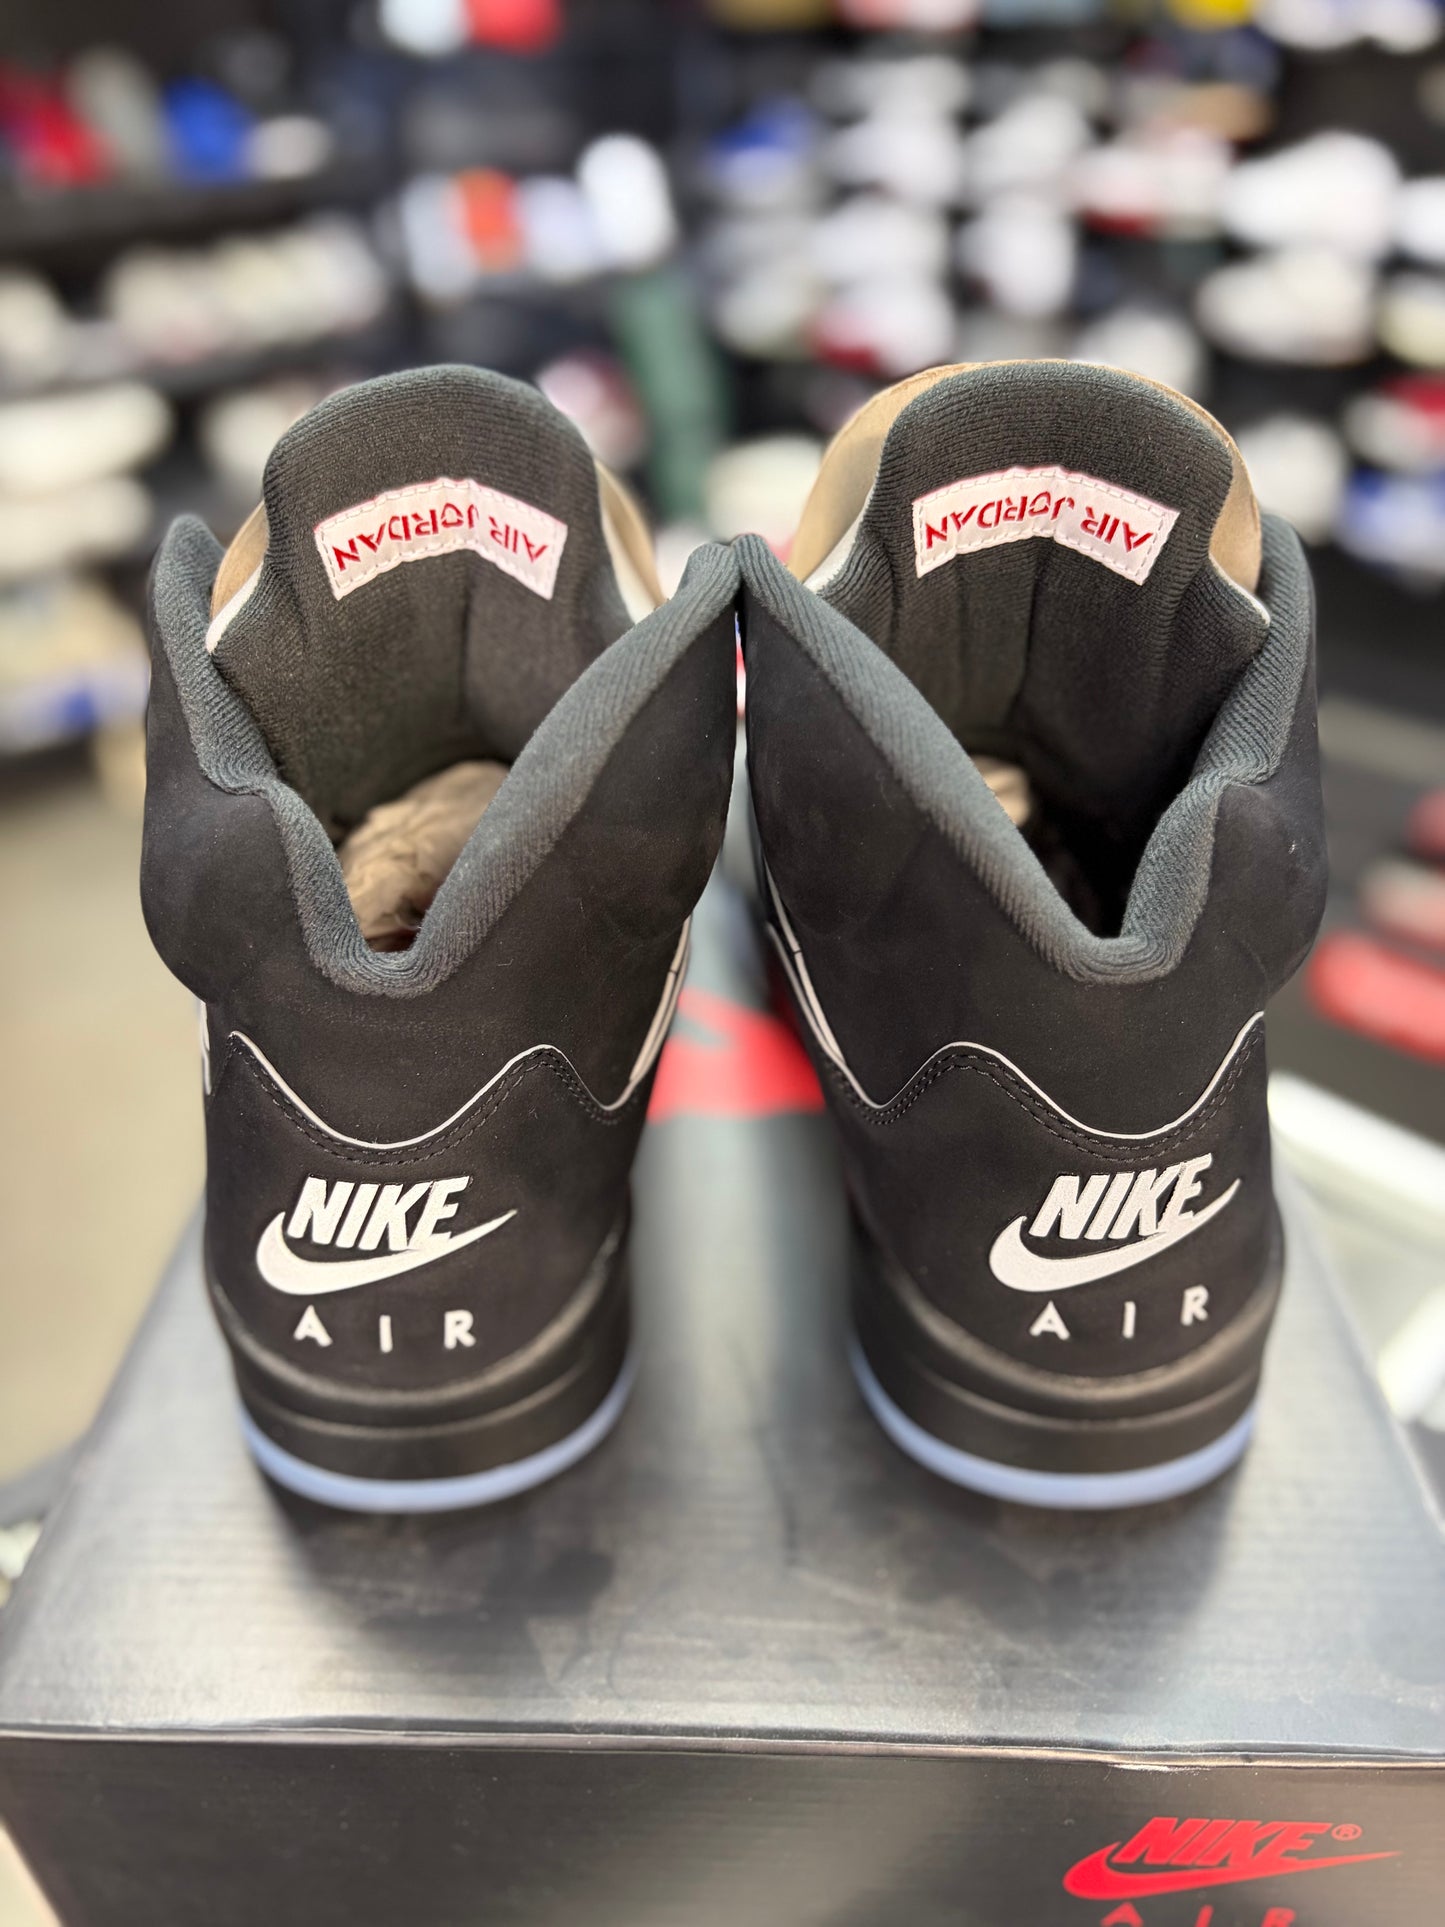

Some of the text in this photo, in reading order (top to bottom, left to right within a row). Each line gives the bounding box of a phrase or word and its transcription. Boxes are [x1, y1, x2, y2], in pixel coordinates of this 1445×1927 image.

[331, 502, 548, 571] AIR JORDAN
[925, 491, 1153, 552] AIR JORDAN
[287, 1175, 470, 1250] NIKE
[1028, 1153, 1212, 1240] NIKE
[293, 1304, 477, 1353] AIR
[1029, 1285, 1209, 1341] AIR
